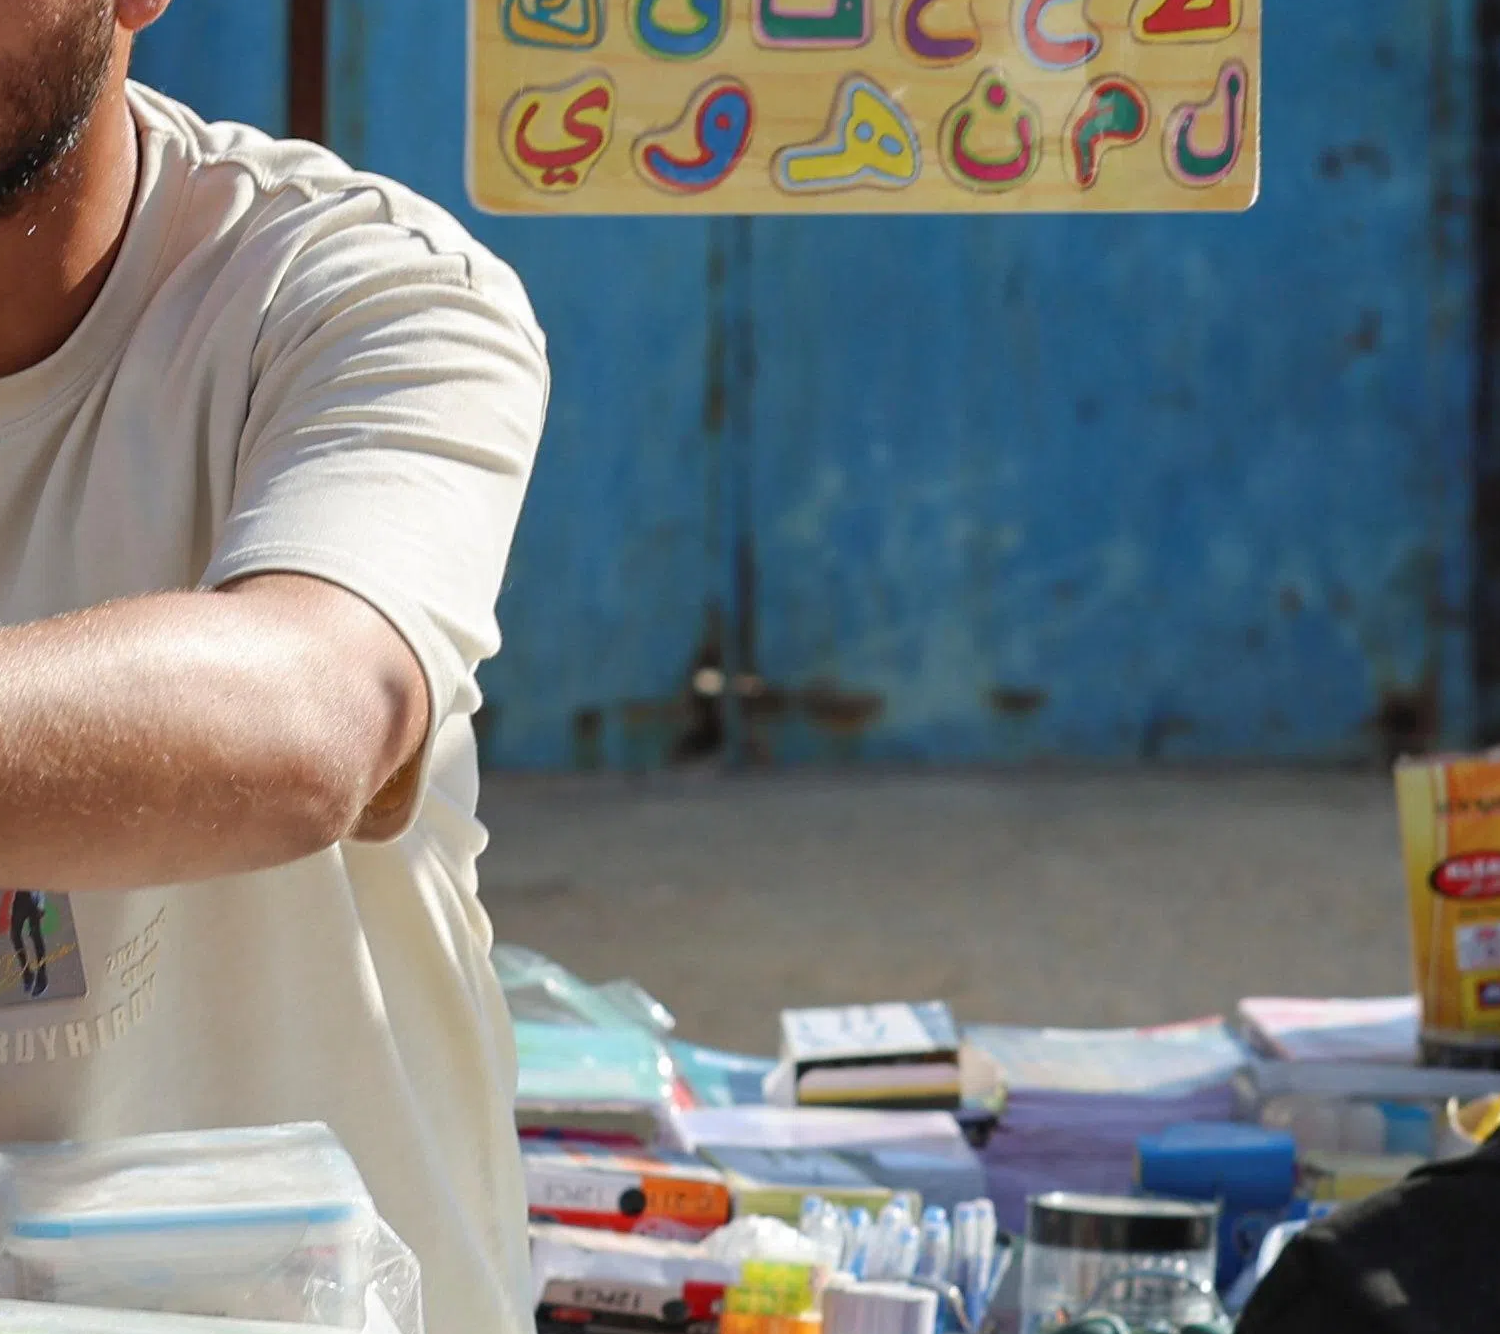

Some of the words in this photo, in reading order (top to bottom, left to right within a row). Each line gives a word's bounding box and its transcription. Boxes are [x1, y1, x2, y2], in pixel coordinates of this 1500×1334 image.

[513, 84, 611, 185] ي
[641, 84, 752, 185] و
[777, 78, 917, 188] ه
[947, 81, 1039, 185] ن
[1073, 81, 1146, 188] م
[1172, 66, 1244, 185] ل
